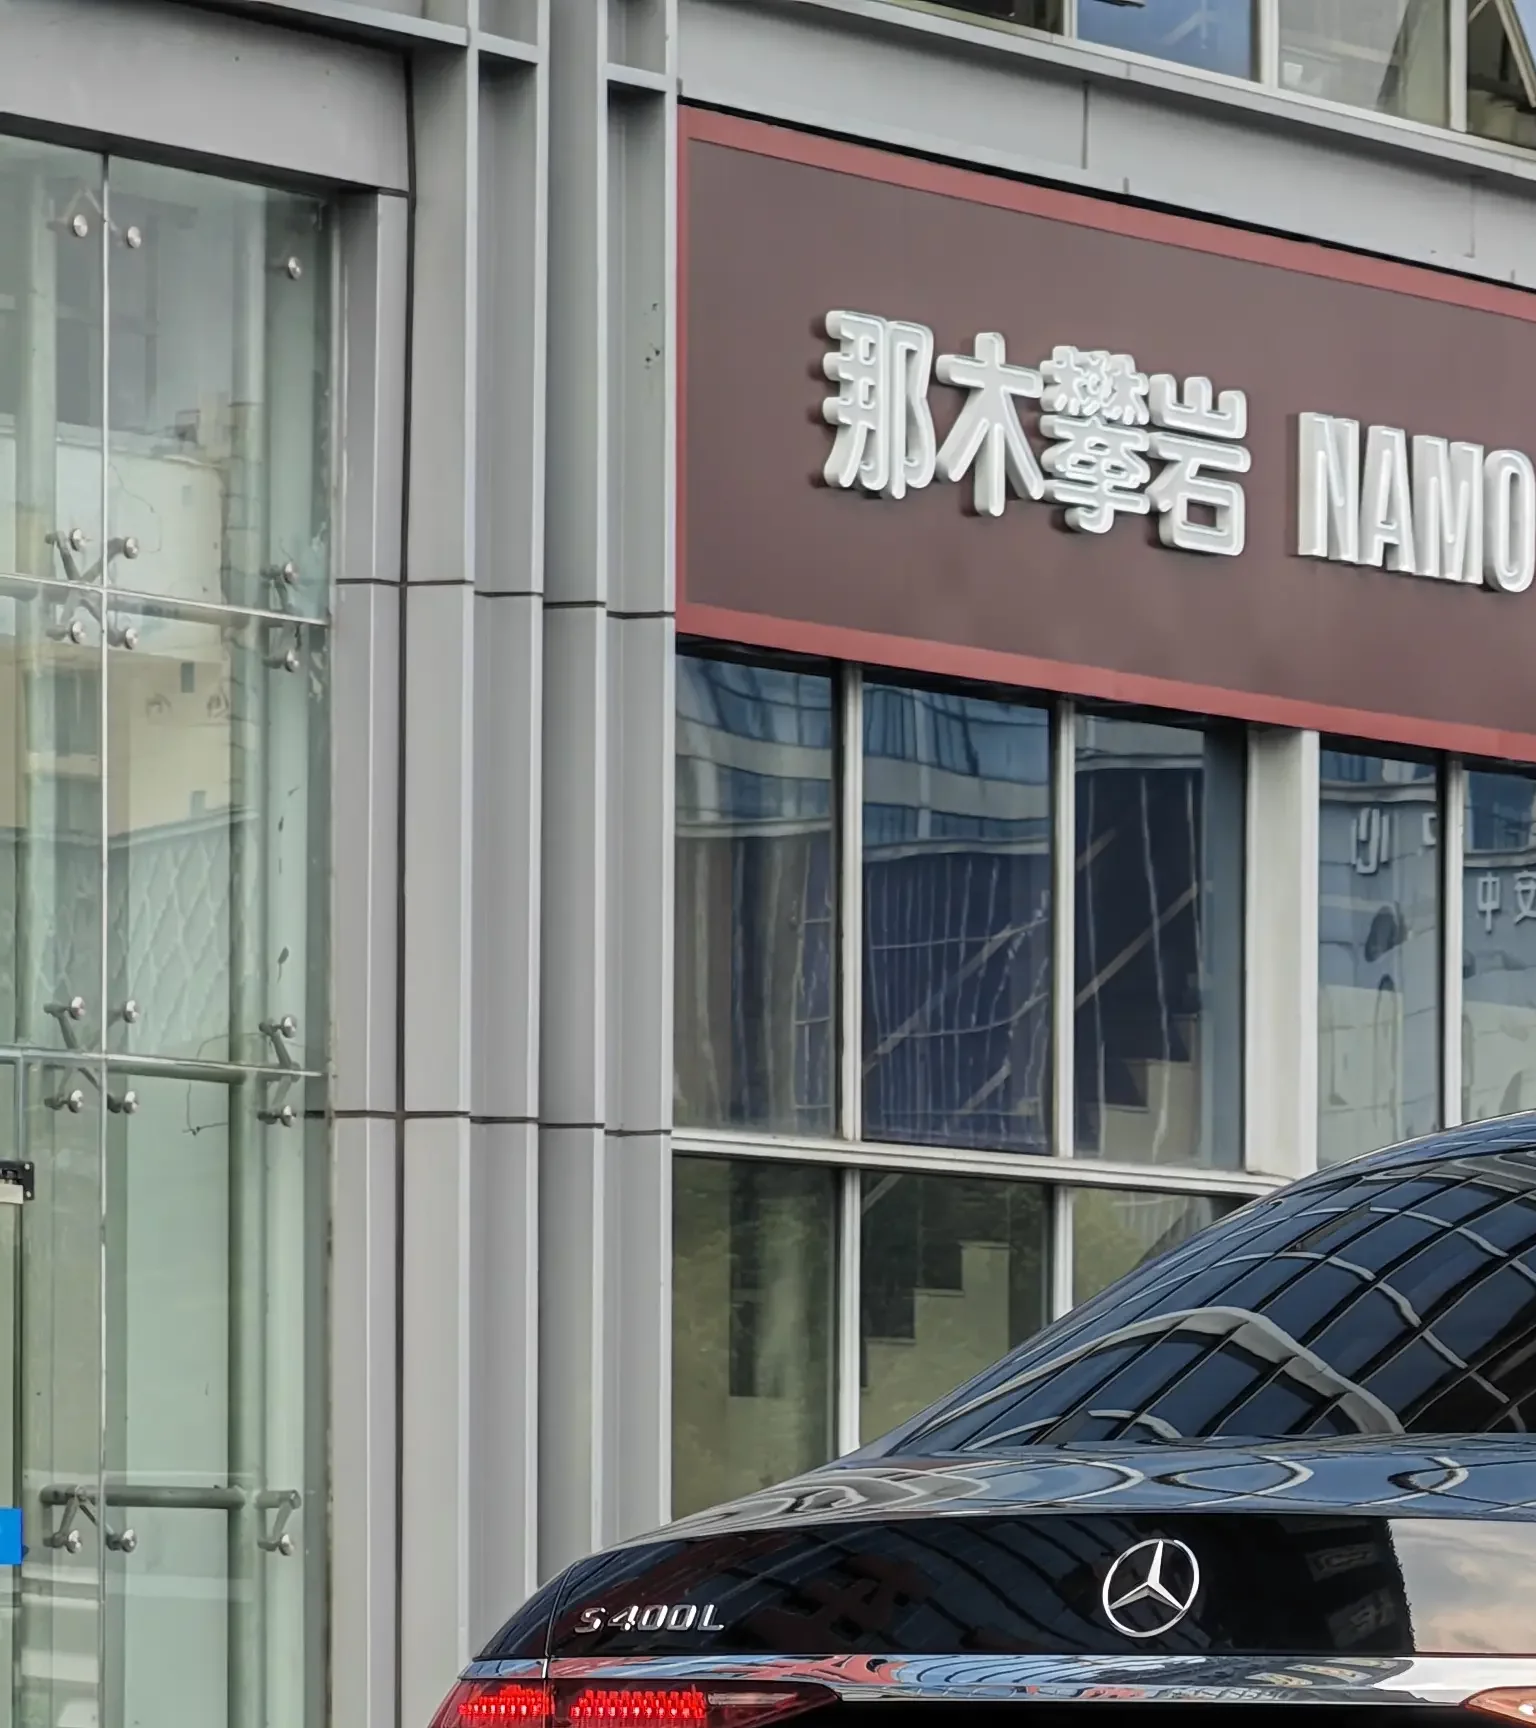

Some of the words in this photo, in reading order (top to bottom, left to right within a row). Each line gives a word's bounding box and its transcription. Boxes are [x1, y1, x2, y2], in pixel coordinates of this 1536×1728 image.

[824, 309, 1251, 556] 那木攀岩
[1298, 411, 1536, 593] NAMO
